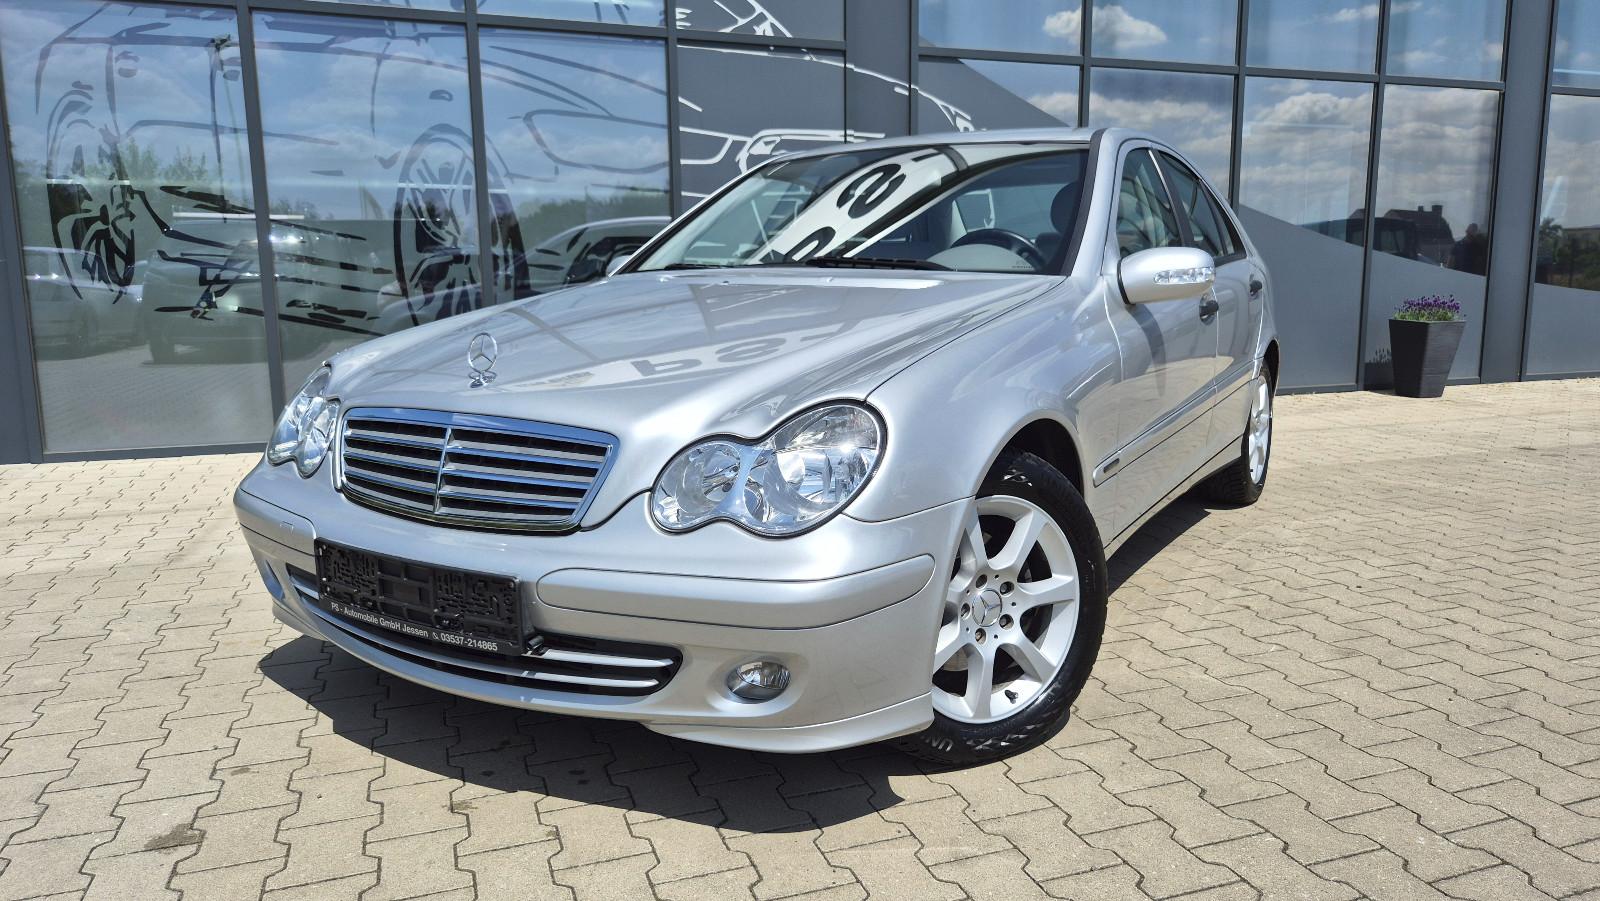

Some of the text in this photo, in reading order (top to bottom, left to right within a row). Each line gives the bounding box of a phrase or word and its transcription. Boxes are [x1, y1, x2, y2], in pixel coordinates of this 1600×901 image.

[331, 602, 340, 612] PS
[344, 607, 379, 624] Automobile
[380, 617, 401, 631] GmbH
[402, 623, 429, 638] Jessen
[441, 632, 498, 652] 03537-214865
